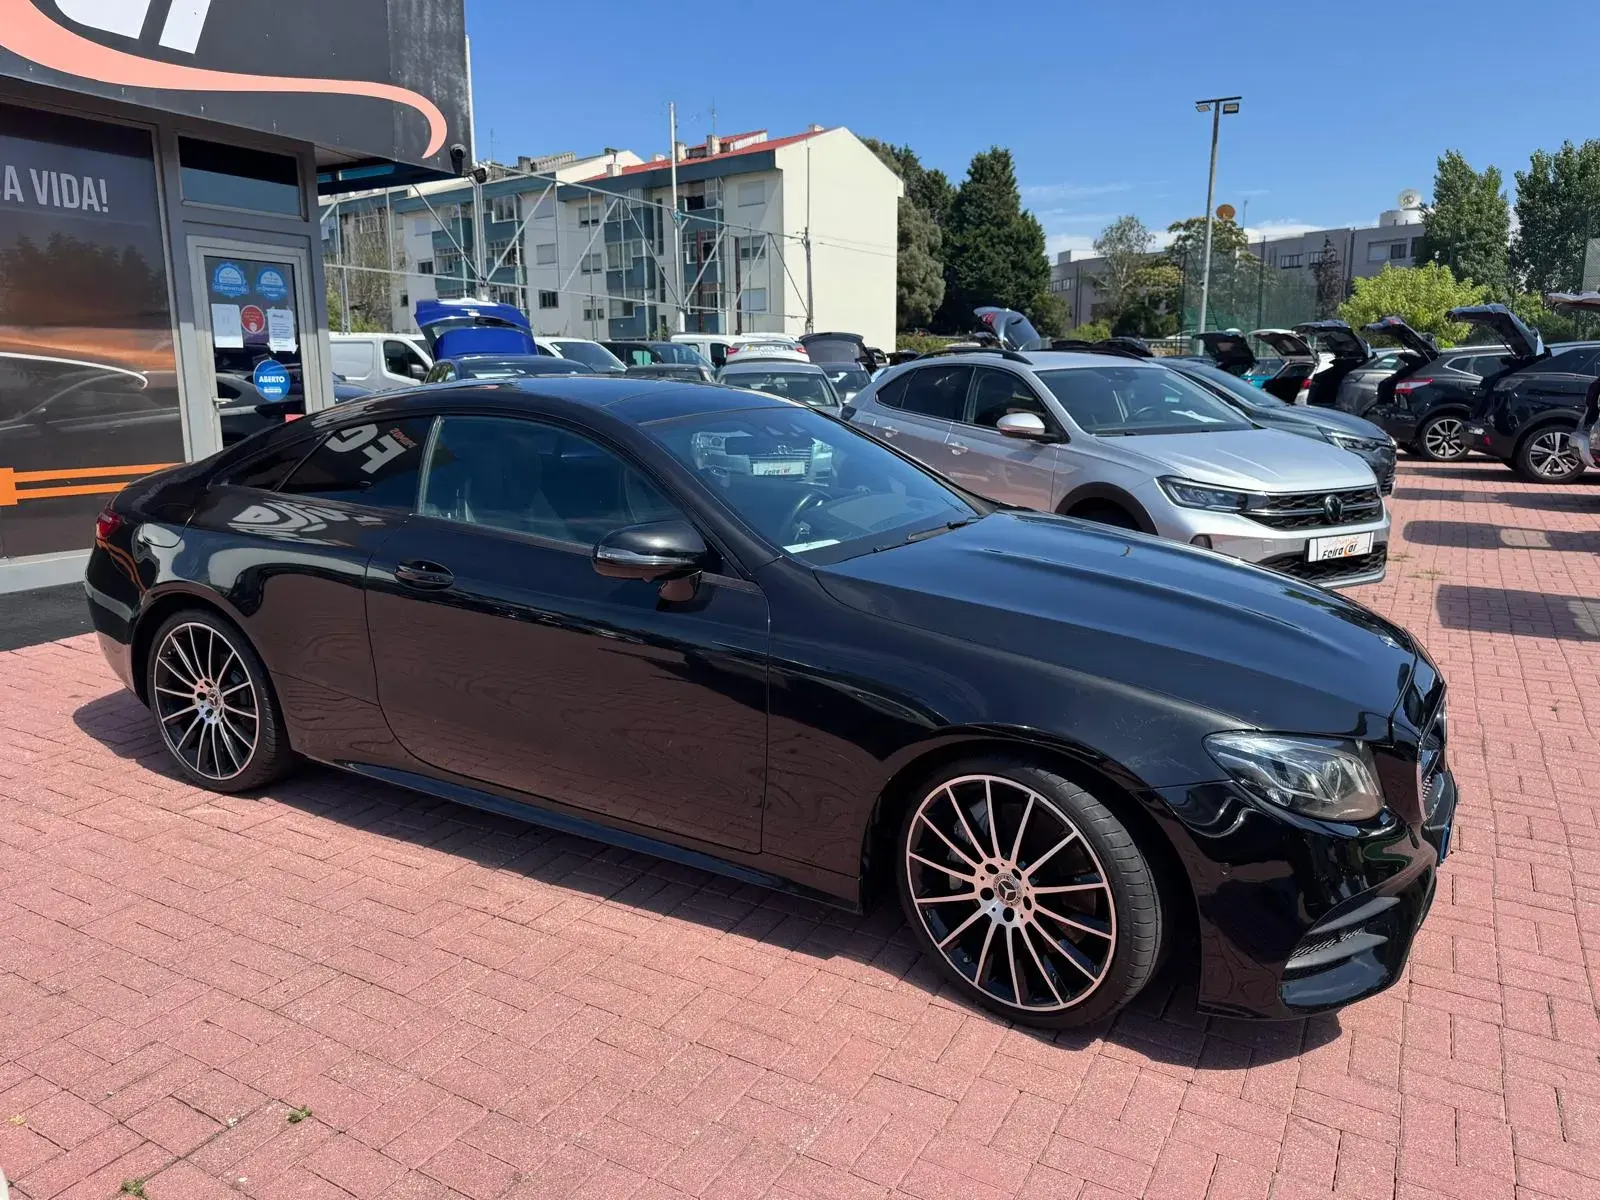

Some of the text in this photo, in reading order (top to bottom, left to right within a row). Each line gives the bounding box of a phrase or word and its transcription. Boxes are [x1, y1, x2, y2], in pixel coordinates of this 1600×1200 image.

[0, 164, 109, 213] A VIDA!
[258, 375, 286, 383] ABERTO
